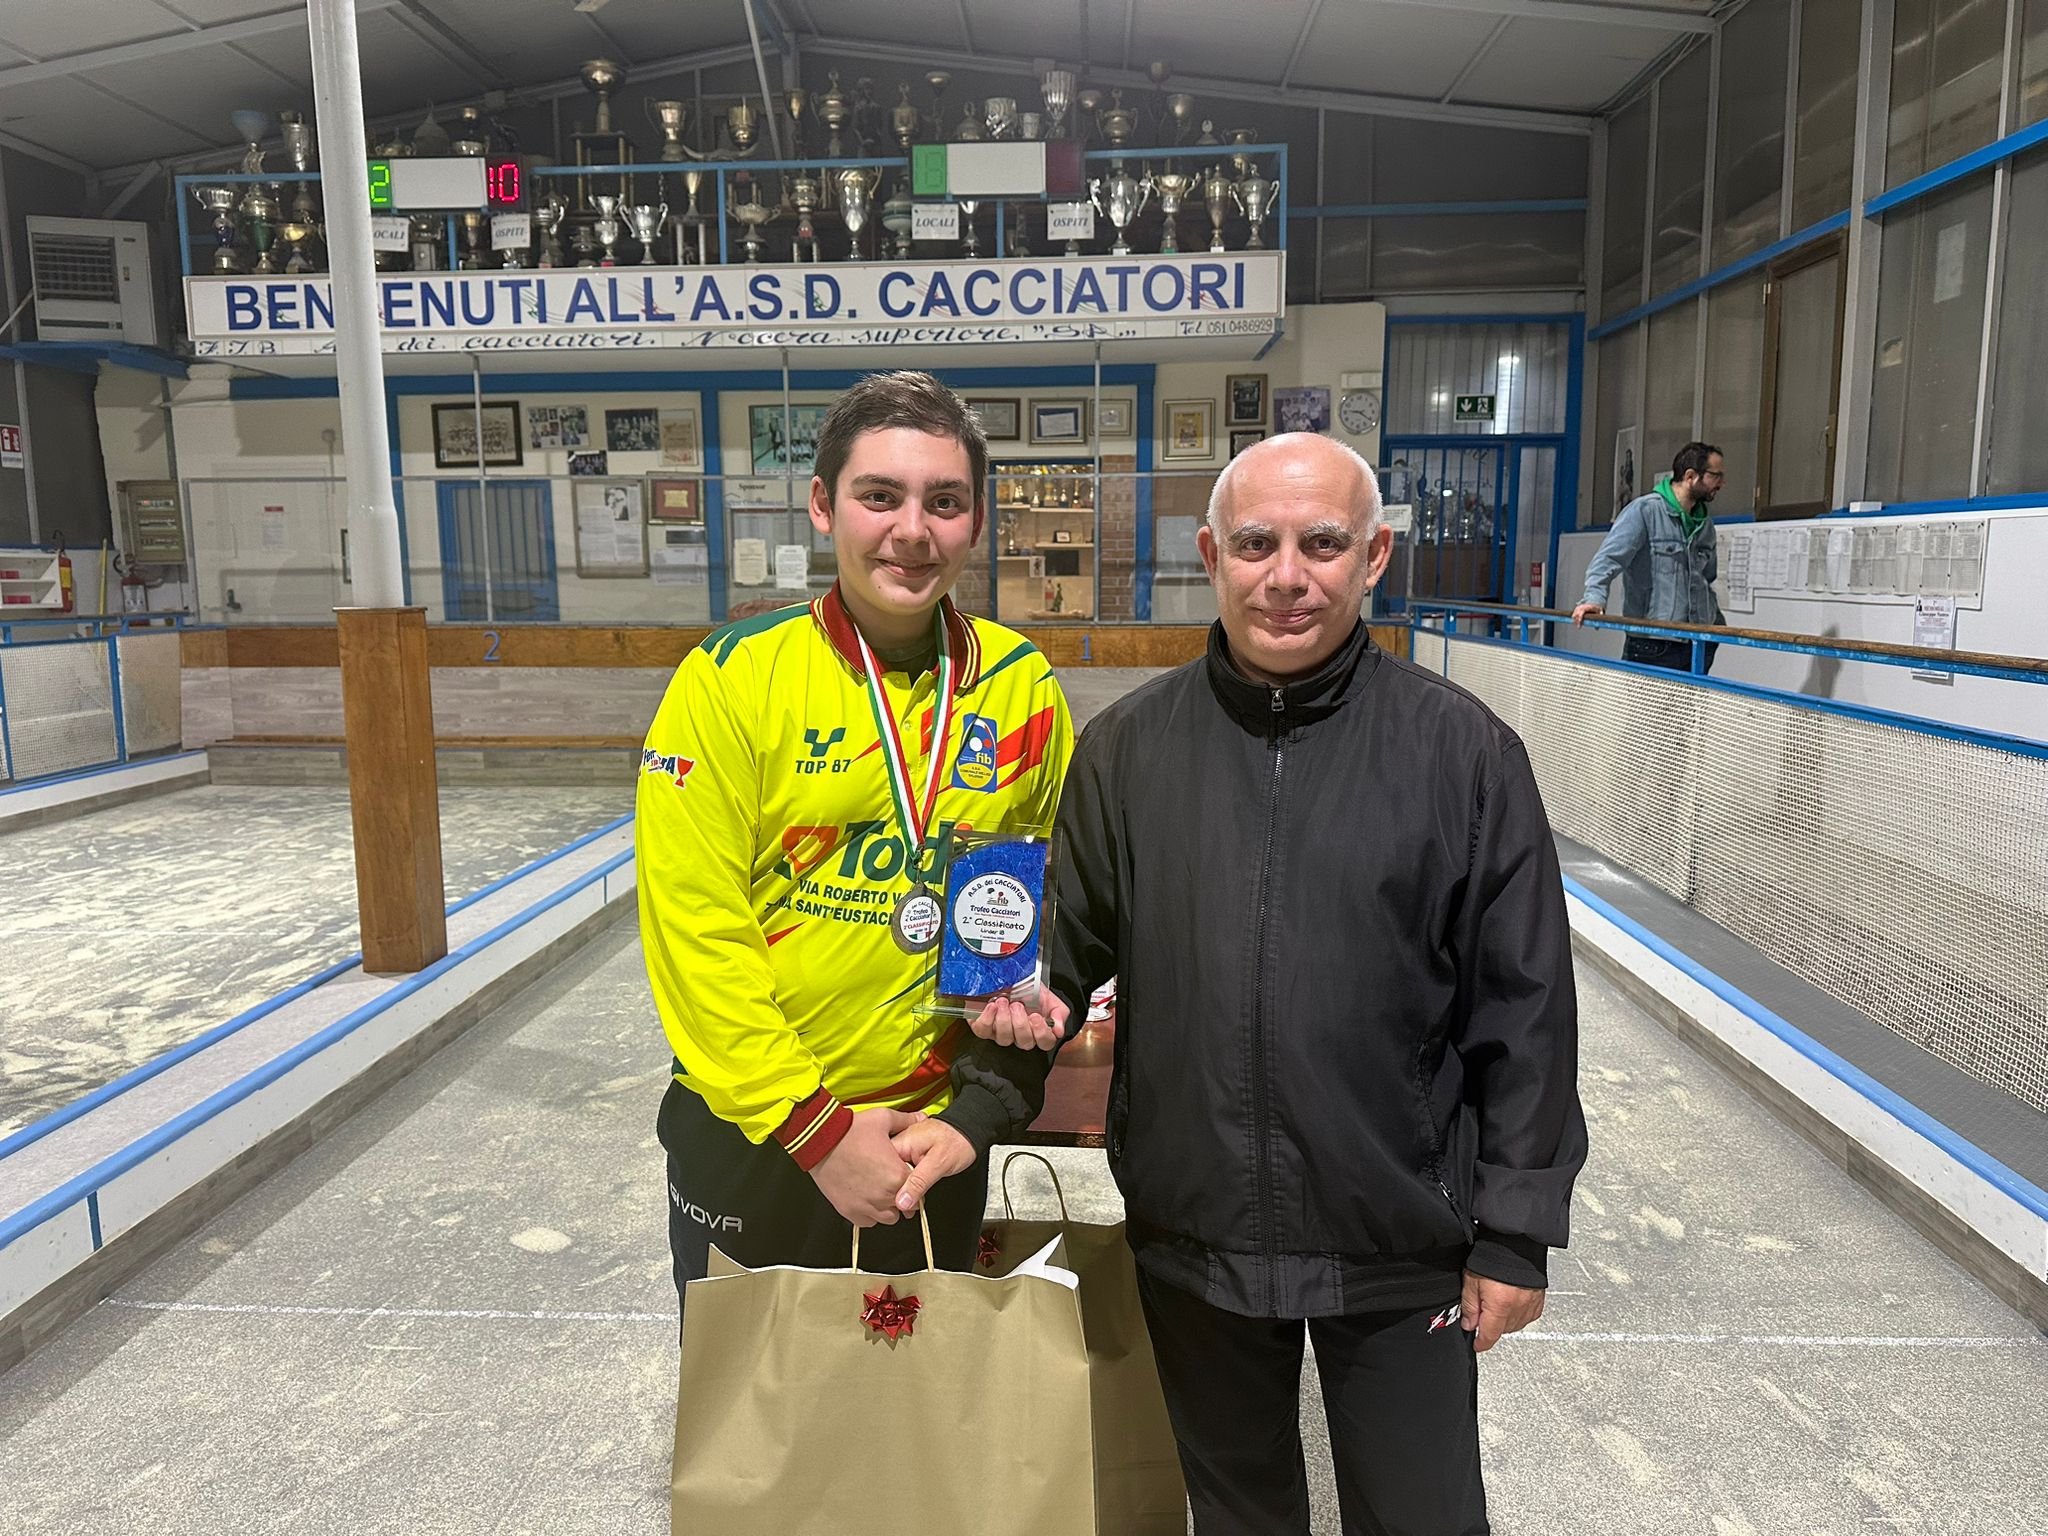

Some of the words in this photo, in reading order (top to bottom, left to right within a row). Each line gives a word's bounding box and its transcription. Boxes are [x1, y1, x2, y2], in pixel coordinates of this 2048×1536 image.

[370, 165, 390, 203] 2
[488, 163, 520, 202] 10
[915, 218, 955, 228] LOCALI
[1053, 217, 1088, 227] OSPITI
[373, 231, 405, 240] OCALI
[495, 229, 526, 237] OSPITI
[225, 279, 547, 331] BENENUTI
[878, 262, 1245, 318] CACCIATORI
[483, 631, 501, 662] 2
[1081, 634, 1094, 661] 1
[795, 760, 827, 774] TOP
[831, 759, 851, 773] 87
[975, 752, 992, 765] fib
[799, 879, 819, 896] VIA
[823, 885, 888, 905] ROBERTO
[994, 879, 1027, 903] CACCIATORI
[796, 899, 893, 926] SANT'EUSTAC
[970, 905, 990, 914] Trofeo
[991, 907, 1021, 916] Cacciatori
[974, 917, 1025, 931] Classificato
